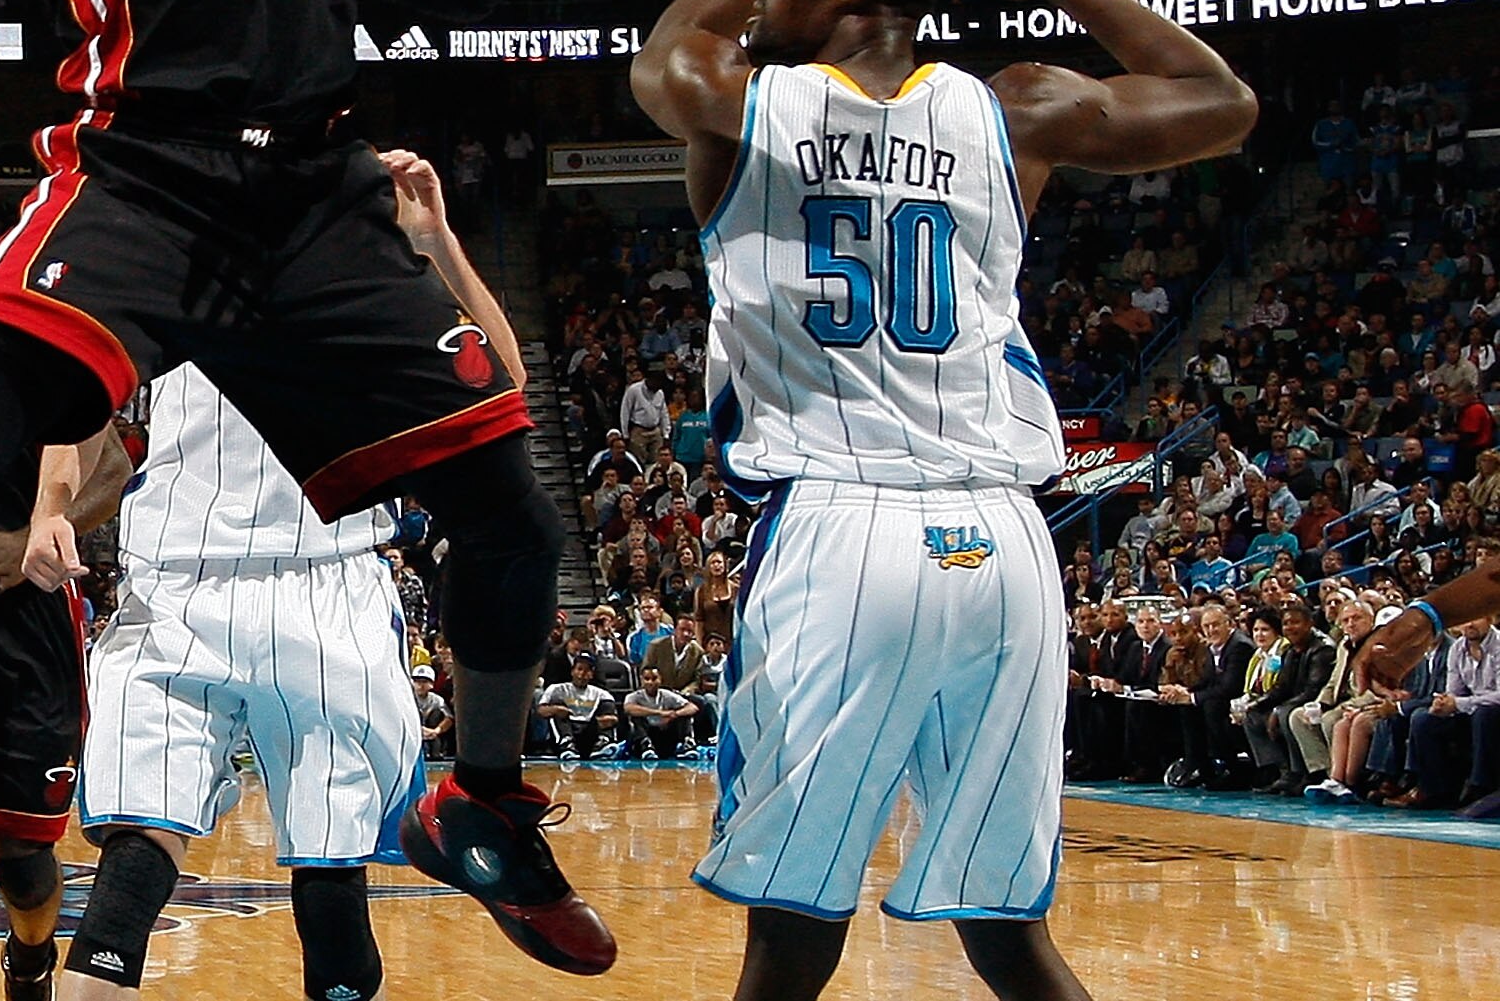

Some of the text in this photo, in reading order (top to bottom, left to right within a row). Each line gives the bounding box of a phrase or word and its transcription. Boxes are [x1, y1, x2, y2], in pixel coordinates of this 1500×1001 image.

[386, 46, 439, 61] adidas
[796, 133, 956, 195] OKAFOR
[800, 194, 960, 355] 50
